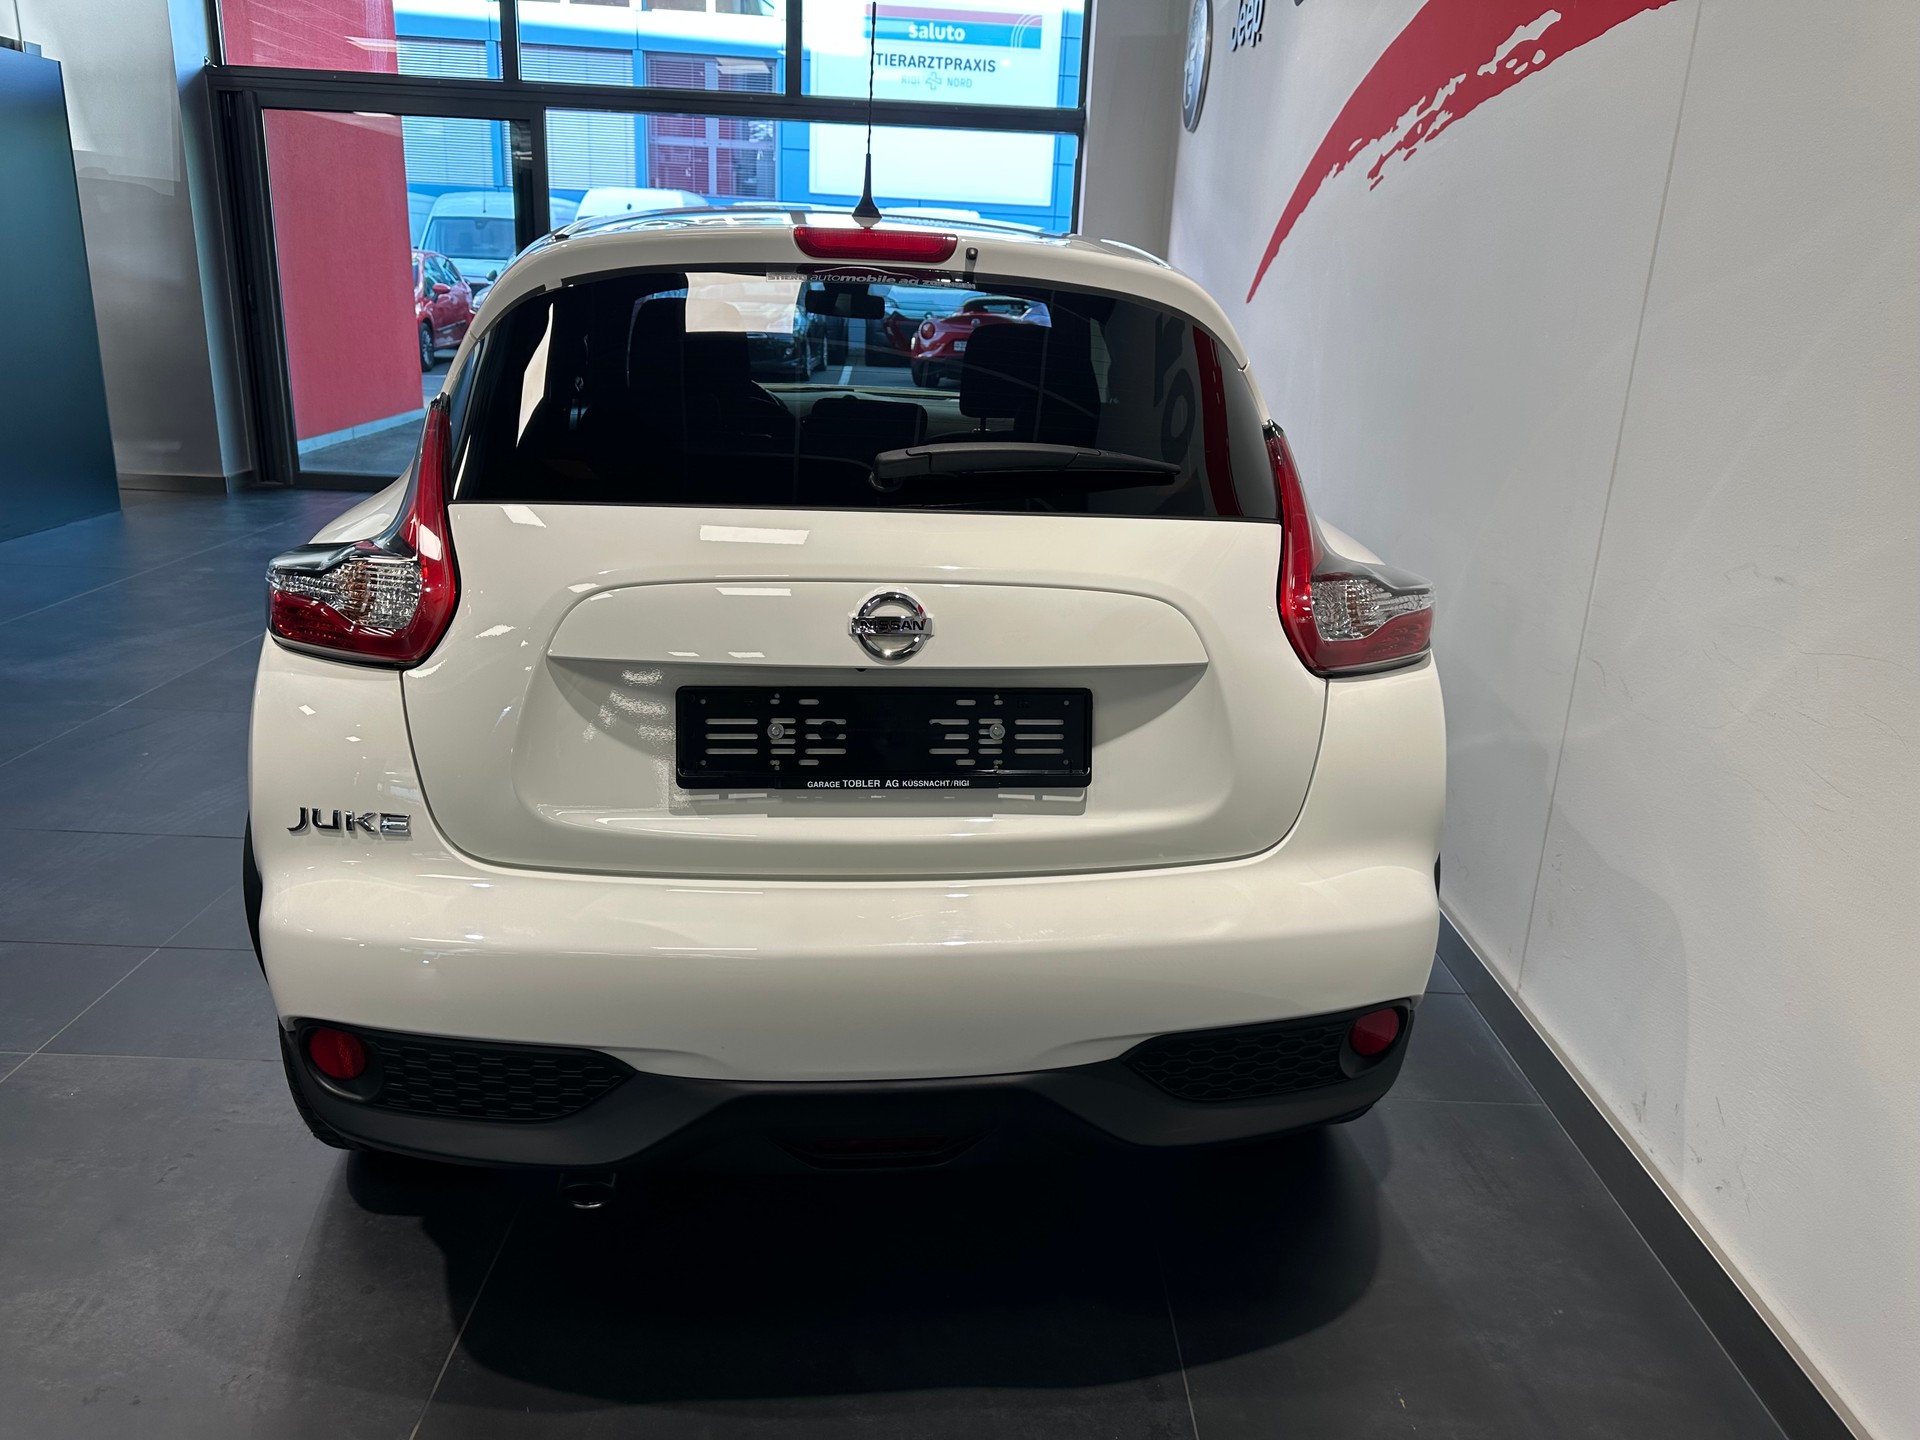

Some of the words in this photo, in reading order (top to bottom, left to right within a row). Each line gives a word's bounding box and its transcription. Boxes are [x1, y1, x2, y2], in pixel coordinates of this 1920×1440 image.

[908, 21, 966, 42] saluto
[876, 53, 996, 73] TIERARZTPRAXIS
[947, 77, 973, 88] NORD
[810, 273, 896, 284] automobile
[860, 619, 924, 631] NISSAN
[842, 779, 881, 788] TOBLER
[885, 779, 899, 788] AG
[902, 779, 970, 787] KÜSSNACHT/RIGI
[286, 806, 411, 833] JUKE
